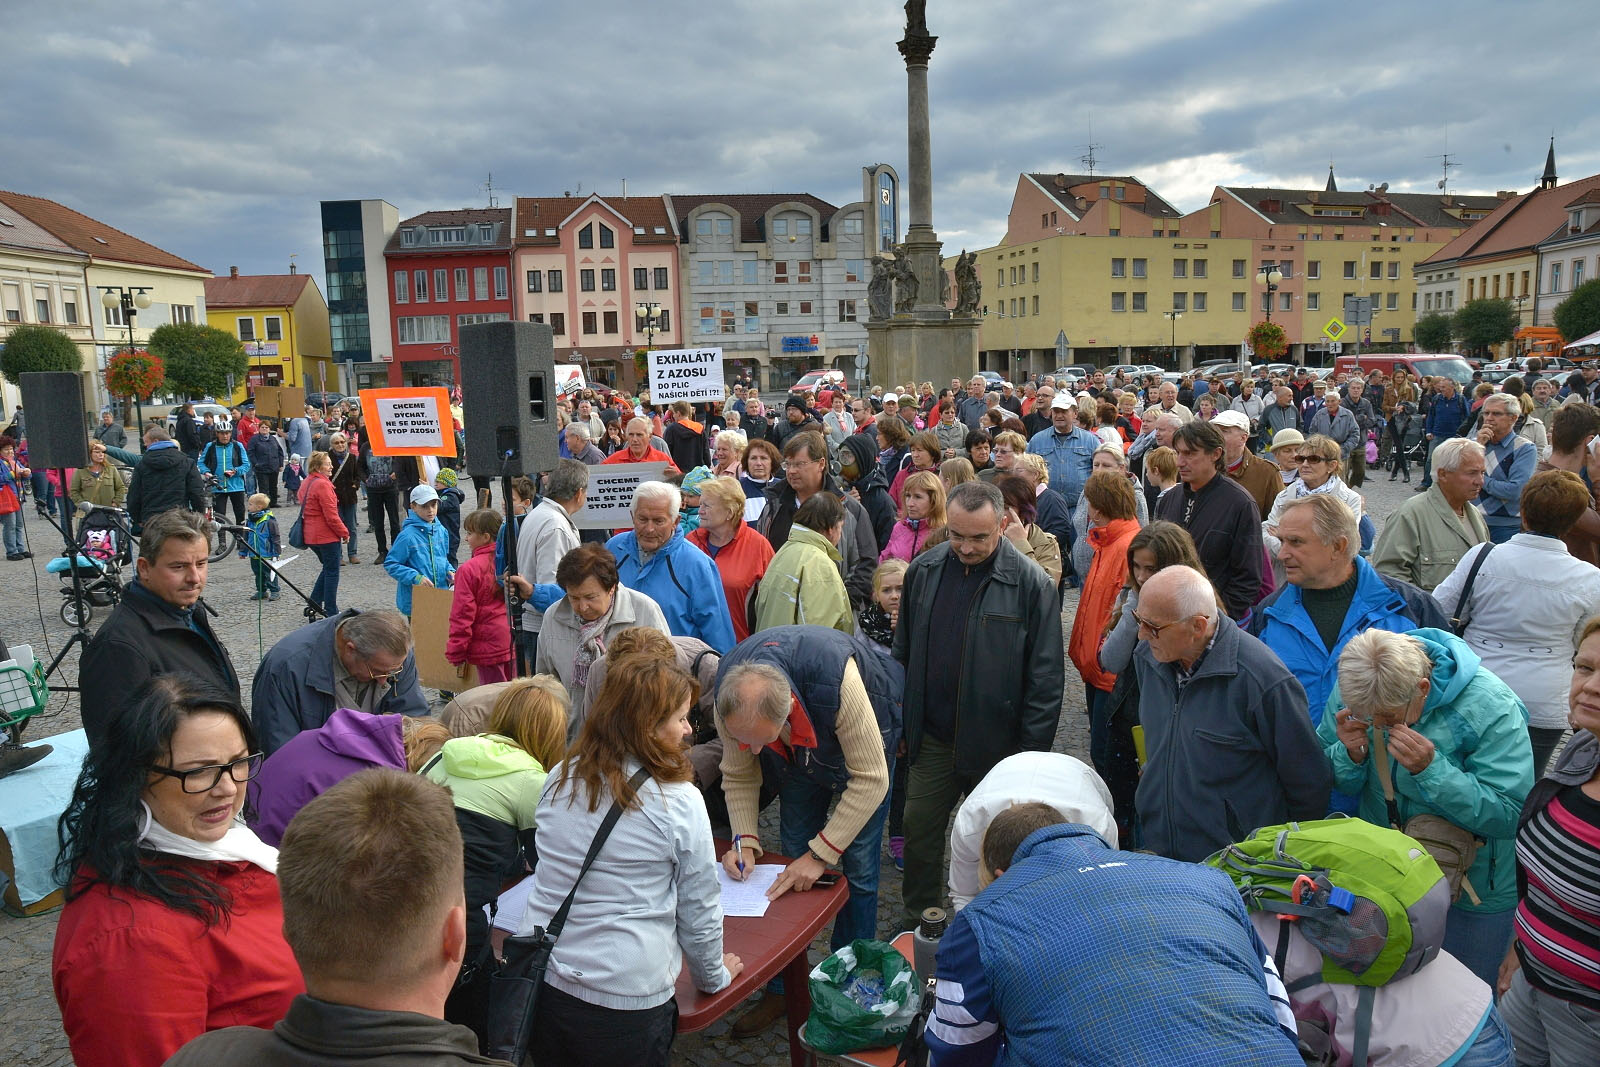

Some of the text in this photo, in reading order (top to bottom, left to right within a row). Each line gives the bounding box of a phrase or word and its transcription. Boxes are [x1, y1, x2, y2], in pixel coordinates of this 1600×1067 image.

[656, 351, 716, 365] EXHALÁTY
[657, 368, 707, 379] Z AZOSU
[658, 390, 688, 399] NAŠICH
[690, 388, 707, 397] DĚTÍ
